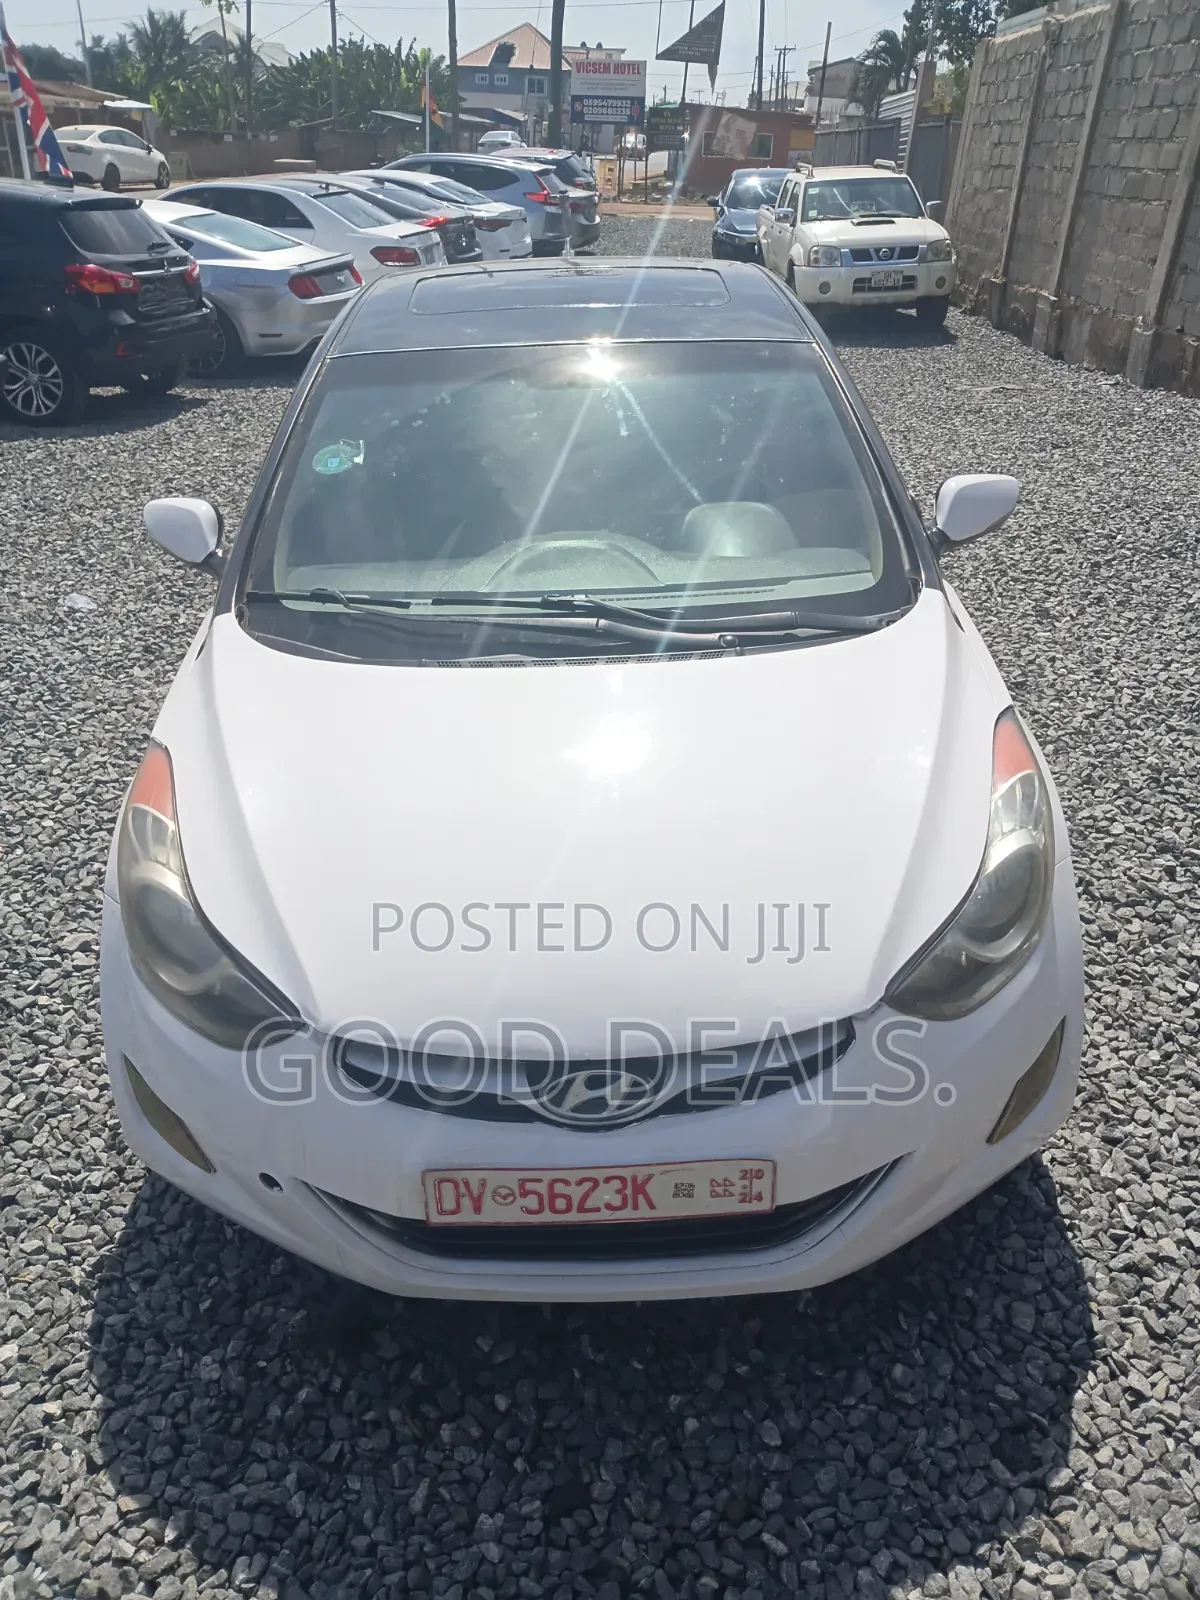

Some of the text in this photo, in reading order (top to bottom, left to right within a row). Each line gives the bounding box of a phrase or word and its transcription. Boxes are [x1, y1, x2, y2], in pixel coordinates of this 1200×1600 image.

[576, 62, 642, 76] VICSEM HOTEL
[518, 1173, 657, 1215] 5623K
